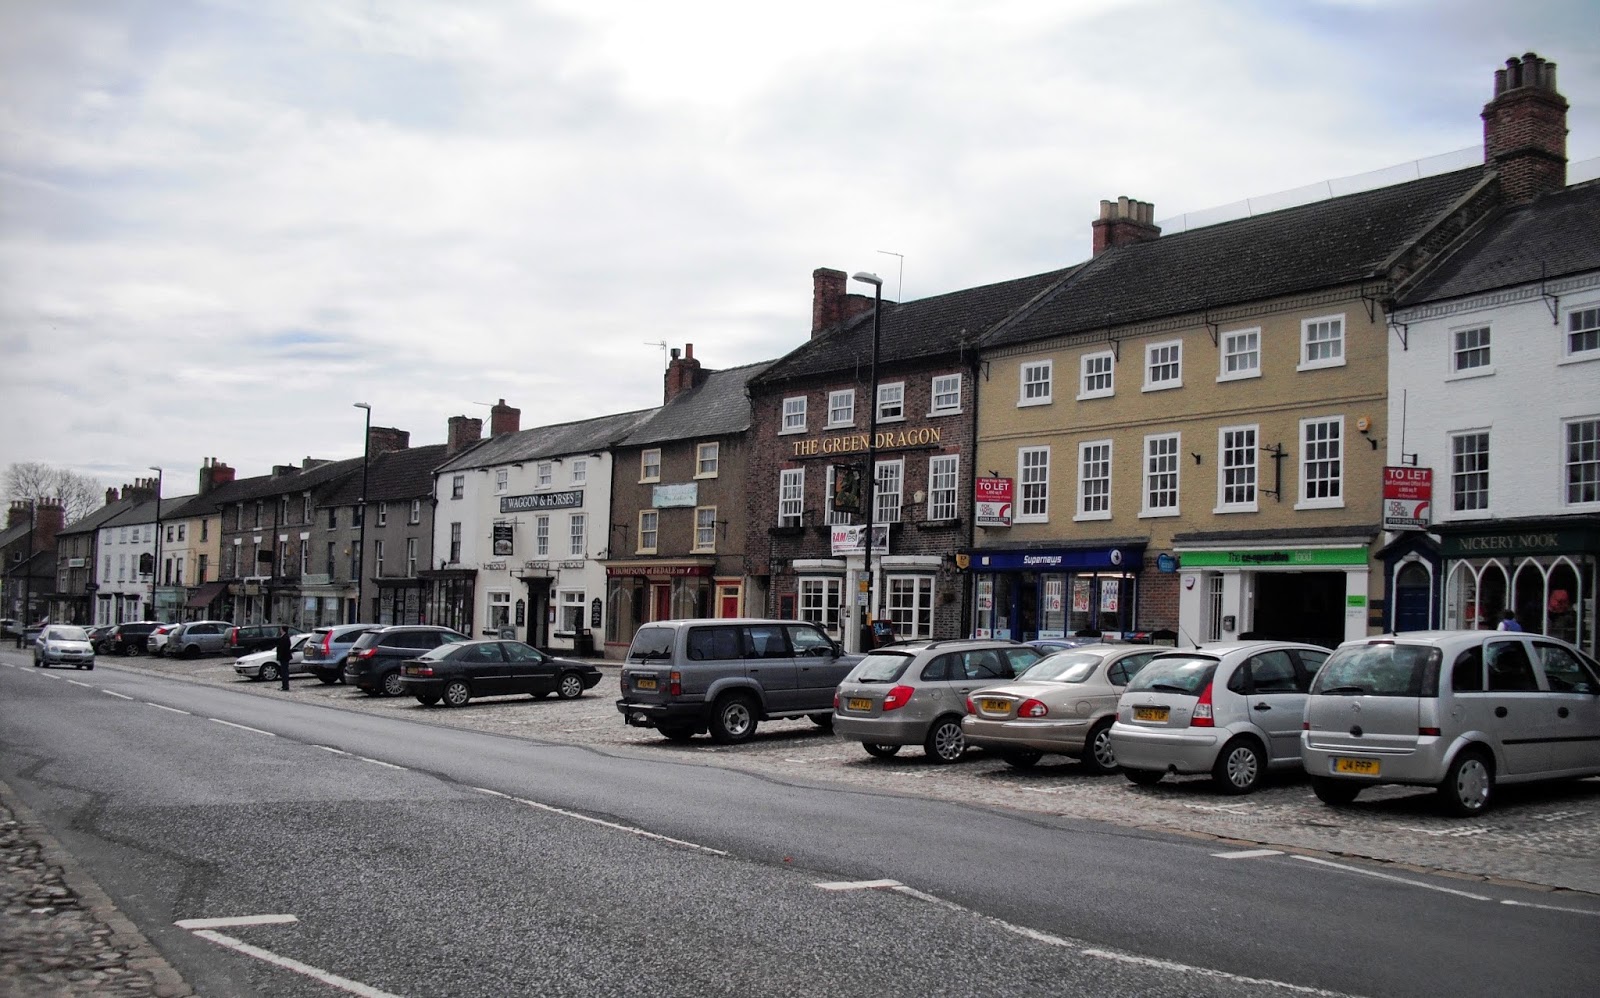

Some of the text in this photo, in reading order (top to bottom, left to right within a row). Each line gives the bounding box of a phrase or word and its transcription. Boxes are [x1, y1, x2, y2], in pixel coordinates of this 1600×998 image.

[793, 427, 941, 456] THE GREEN DRAGON
[1388, 469, 1428, 480] TO LET
[979, 482, 1009, 491] TO LET
[507, 492, 574, 509] WAGGON & HORSES
[1460, 533, 1559, 550] NICKERY NOOK
[1023, 555, 1062, 566] Supernews
[1228, 552, 1240, 562] The
[1295, 550, 1312, 562] food
[612, 567, 646, 575] THOMPSONS
[1342, 760, 1372, 770] J4 PFP
